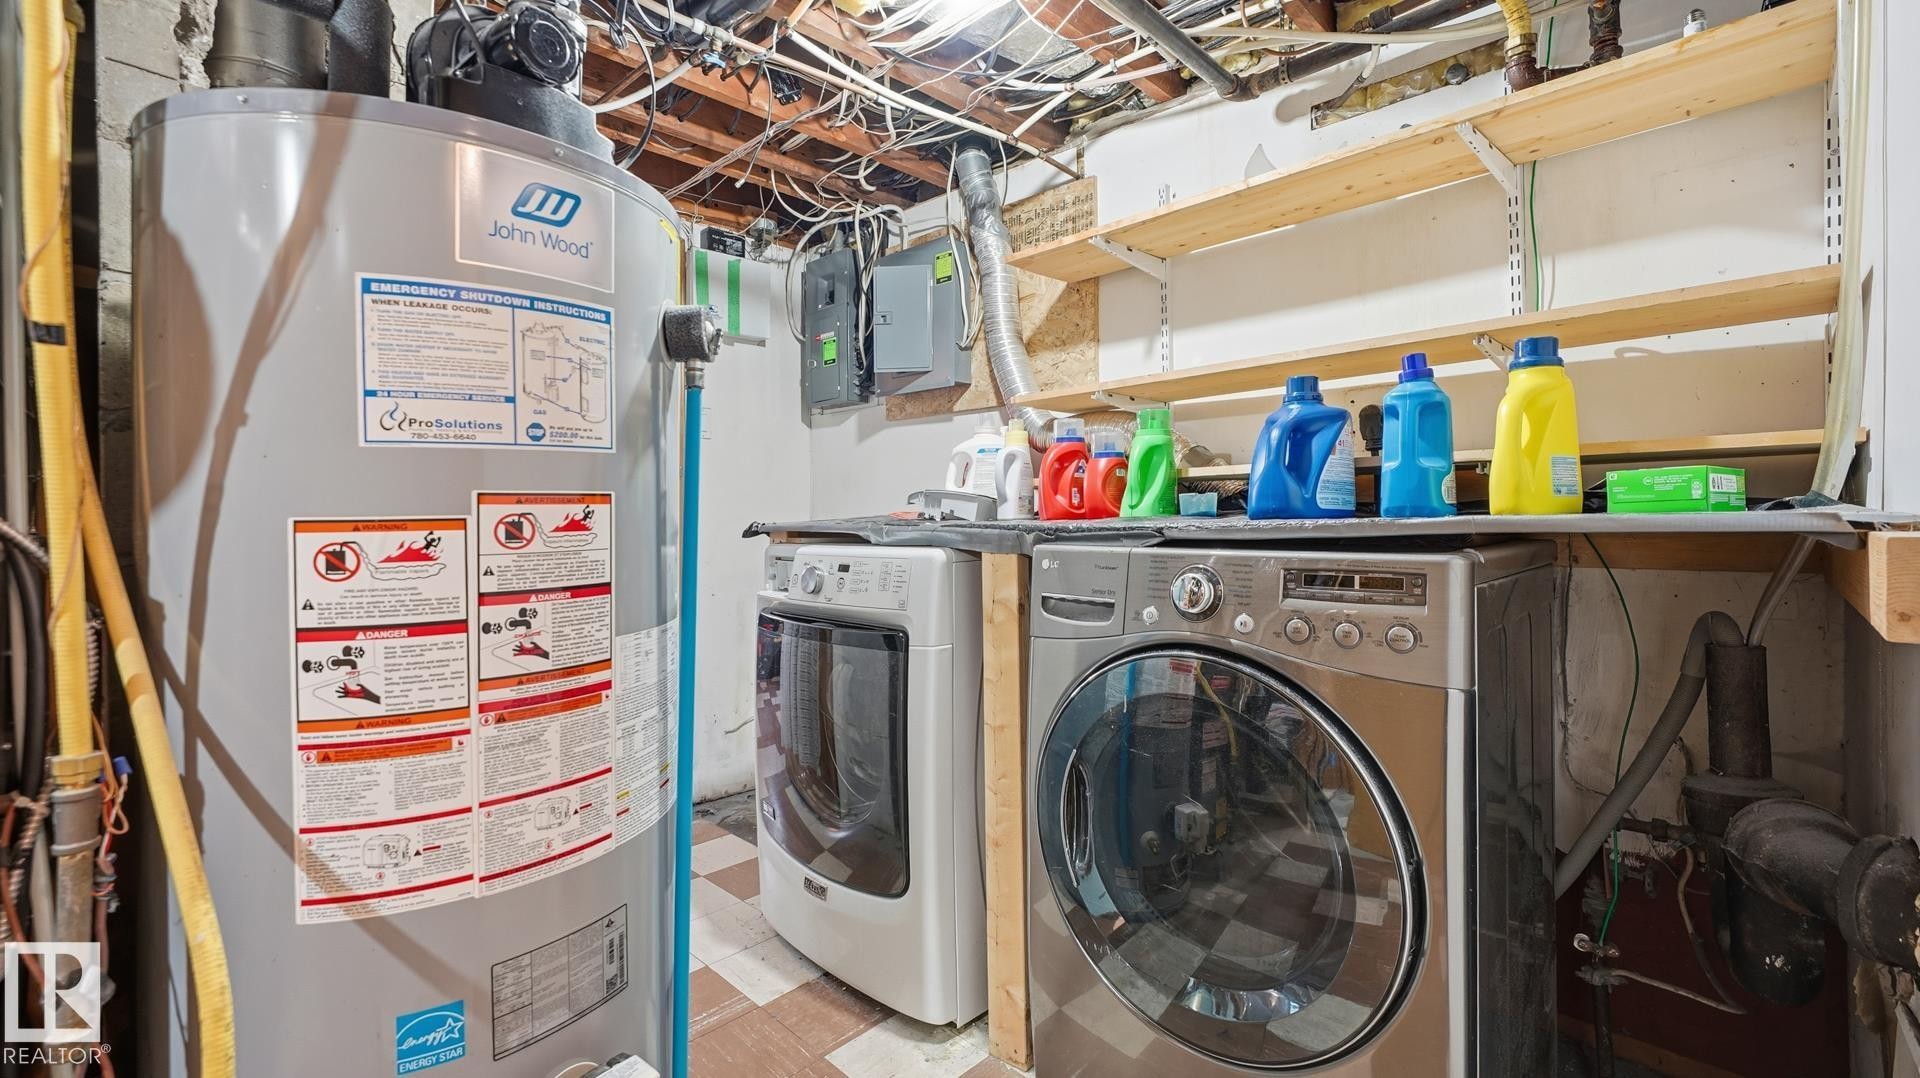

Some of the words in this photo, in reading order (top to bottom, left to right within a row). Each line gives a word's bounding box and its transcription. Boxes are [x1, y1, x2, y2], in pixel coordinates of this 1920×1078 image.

[488, 220, 536, 245] John
[540, 230, 590, 259] Wood
[370, 282, 456, 299] EMERGENCY
[460, 290, 531, 308] SHUTDOWN
[533, 302, 607, 321] INSTRUCTIONS
[371, 298, 400, 306] WHEN
[403, 301, 448, 310] LEAKAGE
[452, 305, 492, 315] OCCURS:
[408, 418, 503, 431] ProSolutions
[411, 432, 477, 440] 780-453-6640
[362, 523, 408, 531] WARNING
[539, 592, 571, 601] DANGER
[366, 630, 408, 639] DANGER
[366, 718, 412, 728] WARNING
[400, 1054, 437, 1073] ENERGY
[439, 1047, 463, 1062] STAR
